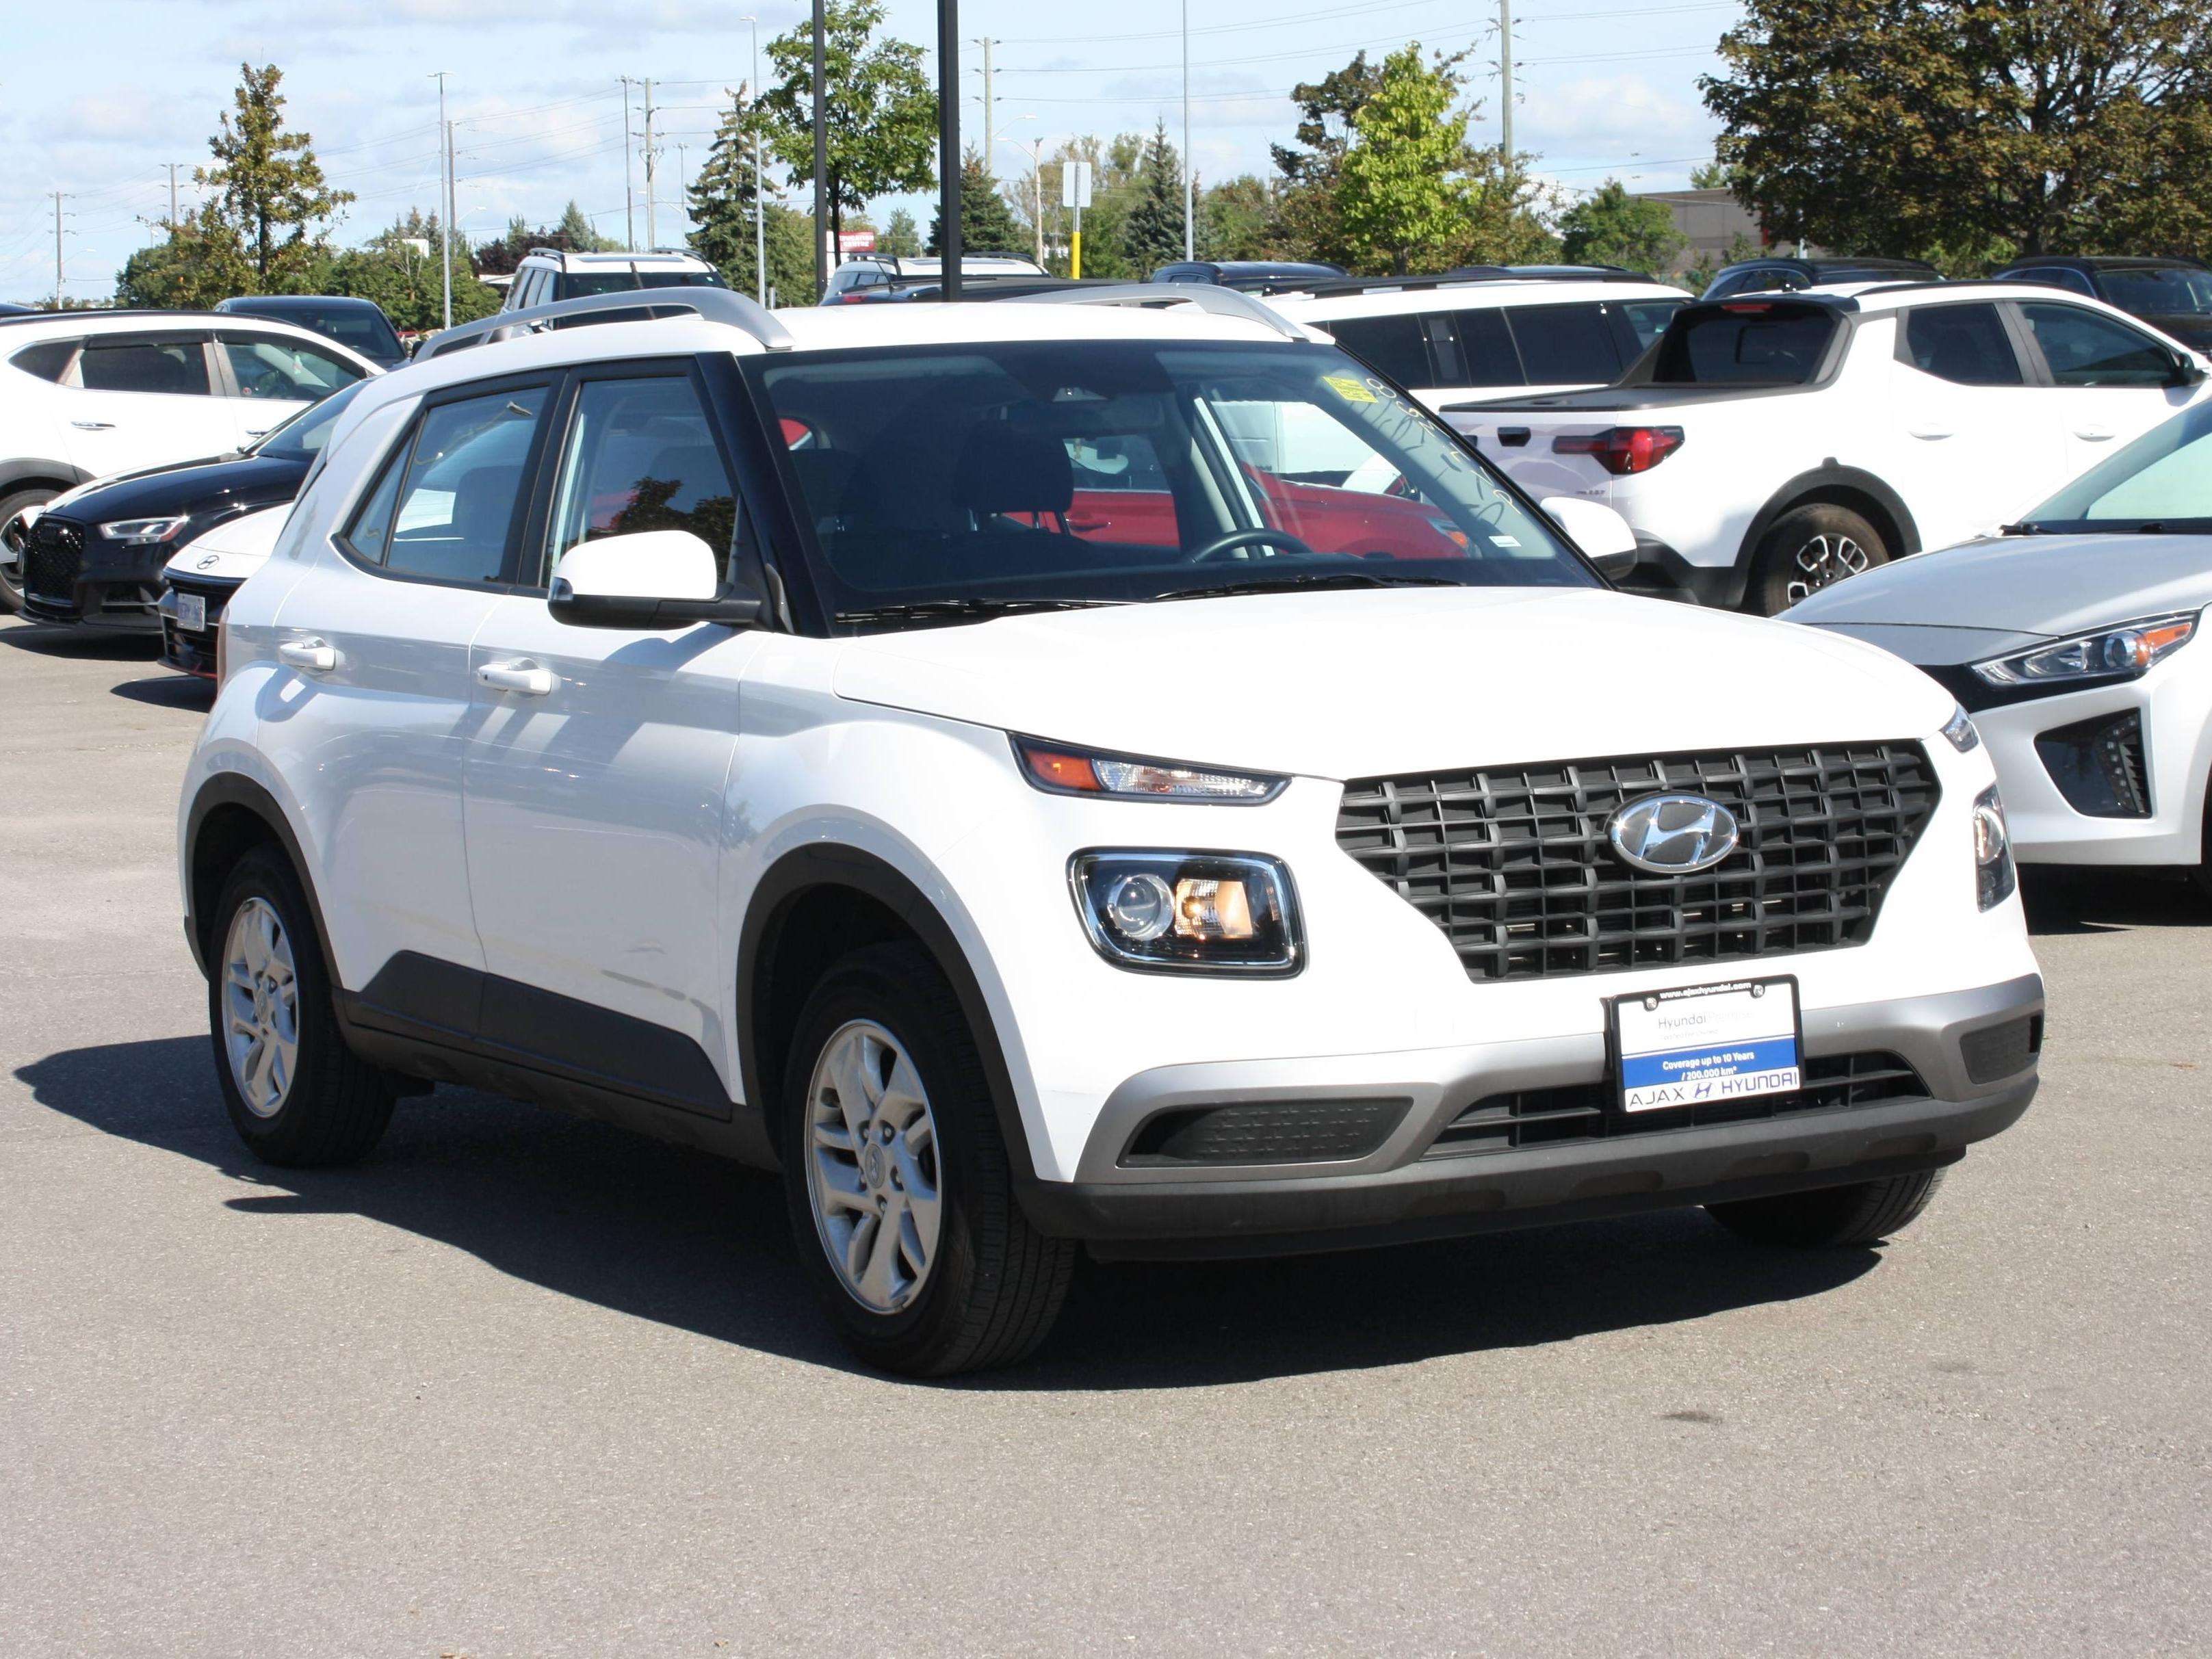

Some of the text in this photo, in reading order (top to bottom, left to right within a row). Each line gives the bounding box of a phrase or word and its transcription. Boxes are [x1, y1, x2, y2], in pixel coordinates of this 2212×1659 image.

[1659, 982, 1752, 999] www.ajaxhyundai.com
[1658, 1014, 1706, 1030] Hyundai
[1663, 1051, 1755, 1070] Coverage up to 10 Years
[1630, 1072, 1797, 1107] AJAX HYUNDAI
